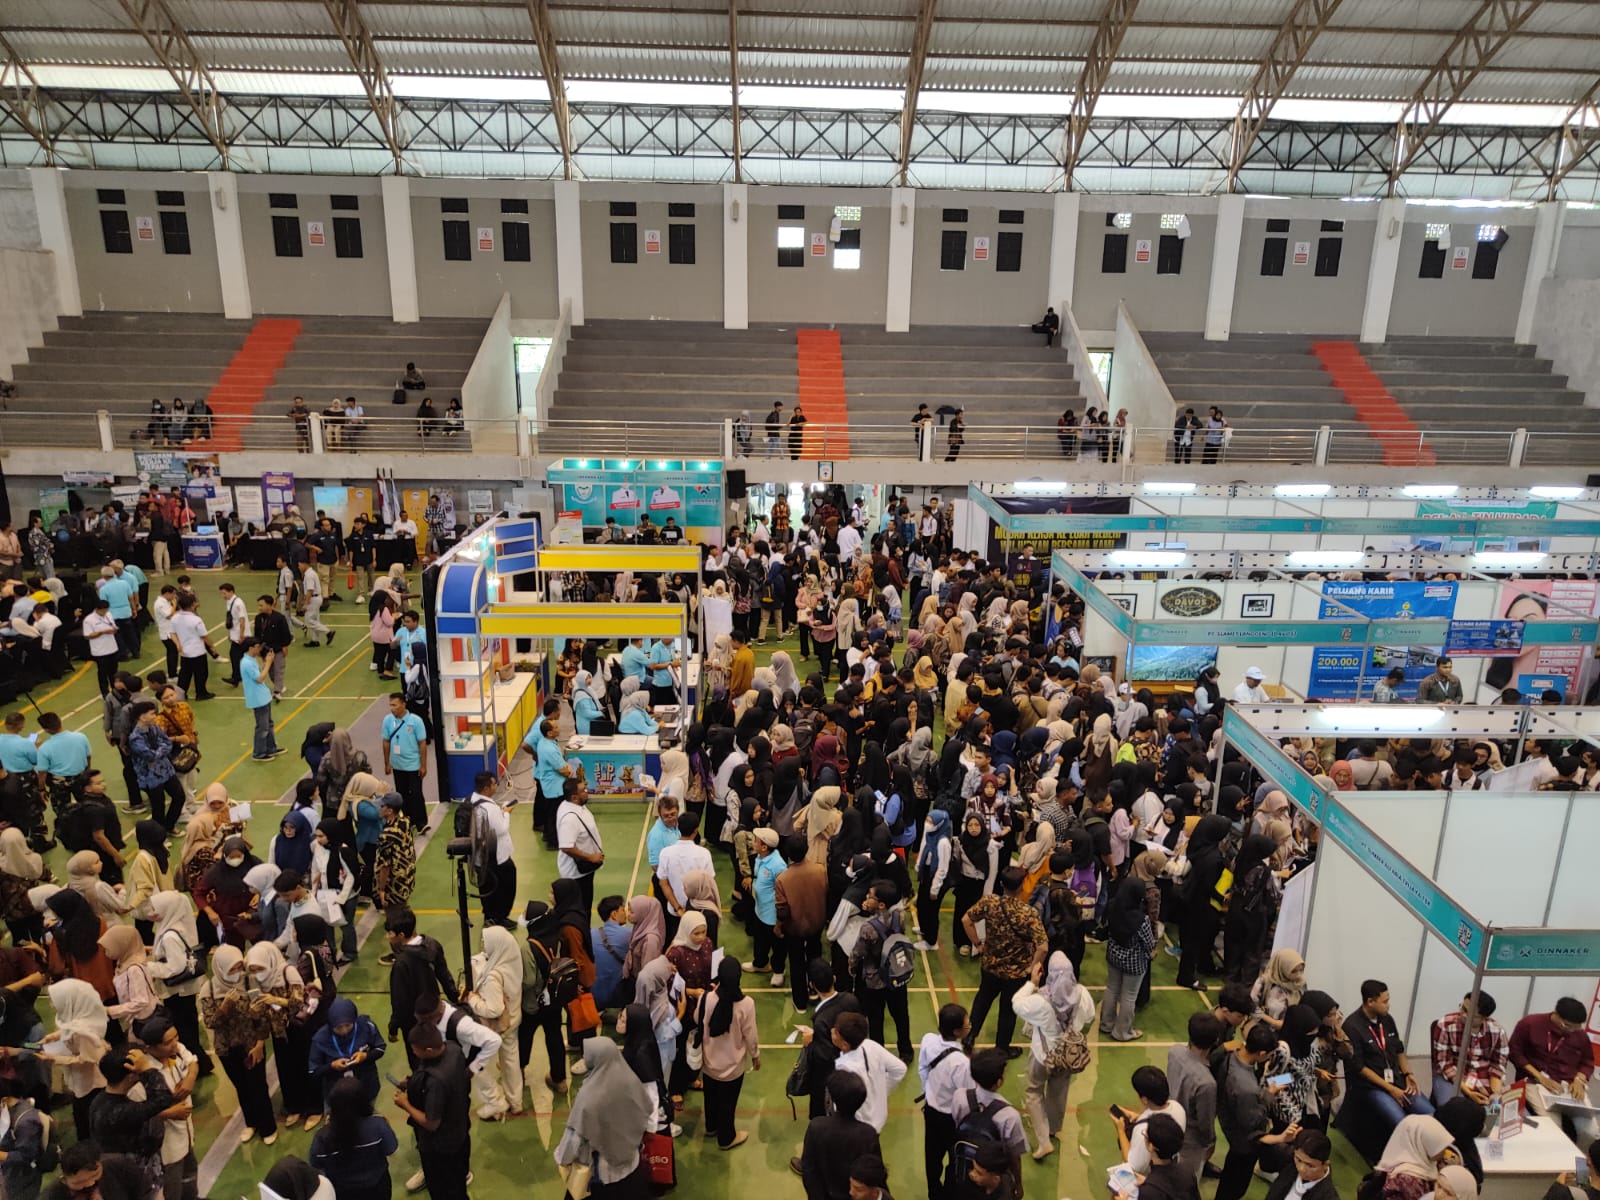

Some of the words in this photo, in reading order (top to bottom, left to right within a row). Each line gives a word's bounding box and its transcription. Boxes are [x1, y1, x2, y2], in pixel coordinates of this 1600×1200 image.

[1368, 586, 1394, 595] KARIR
[1174, 597, 1207, 607] DAVOS
[1317, 657, 1359, 667] 200.000
[1536, 947, 1590, 955] DINNAKER
